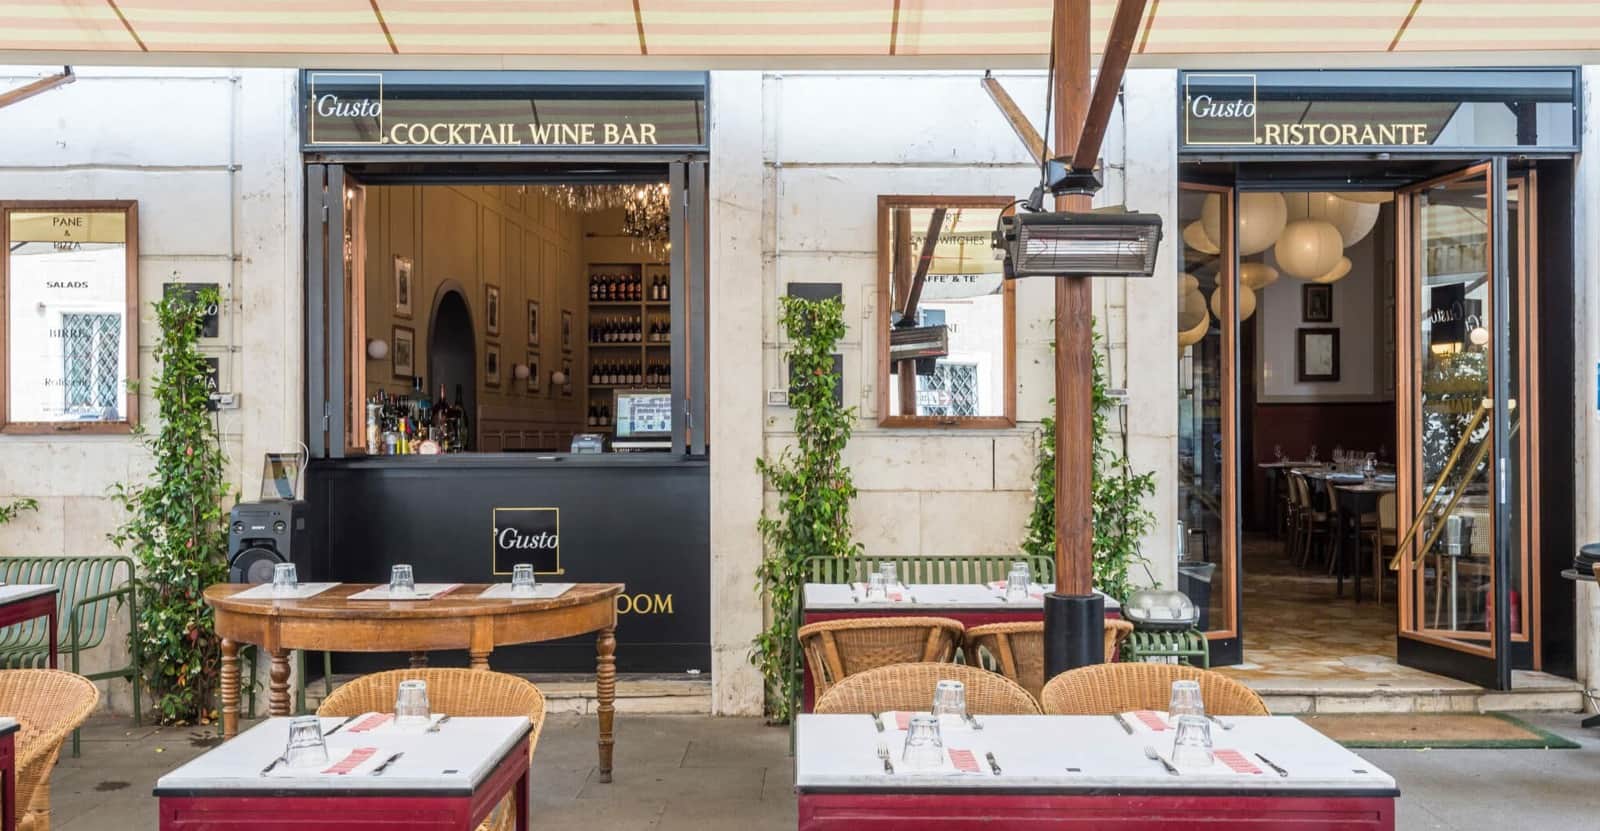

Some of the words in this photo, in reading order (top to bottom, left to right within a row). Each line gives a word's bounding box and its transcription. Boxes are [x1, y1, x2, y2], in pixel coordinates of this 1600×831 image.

[529, 123, 595, 145] WINE
[604, 123, 657, 145] BAR
[52, 216, 82, 227] PANE
[952, 275, 960, 283] &
[46, 281, 89, 289] SALADS
